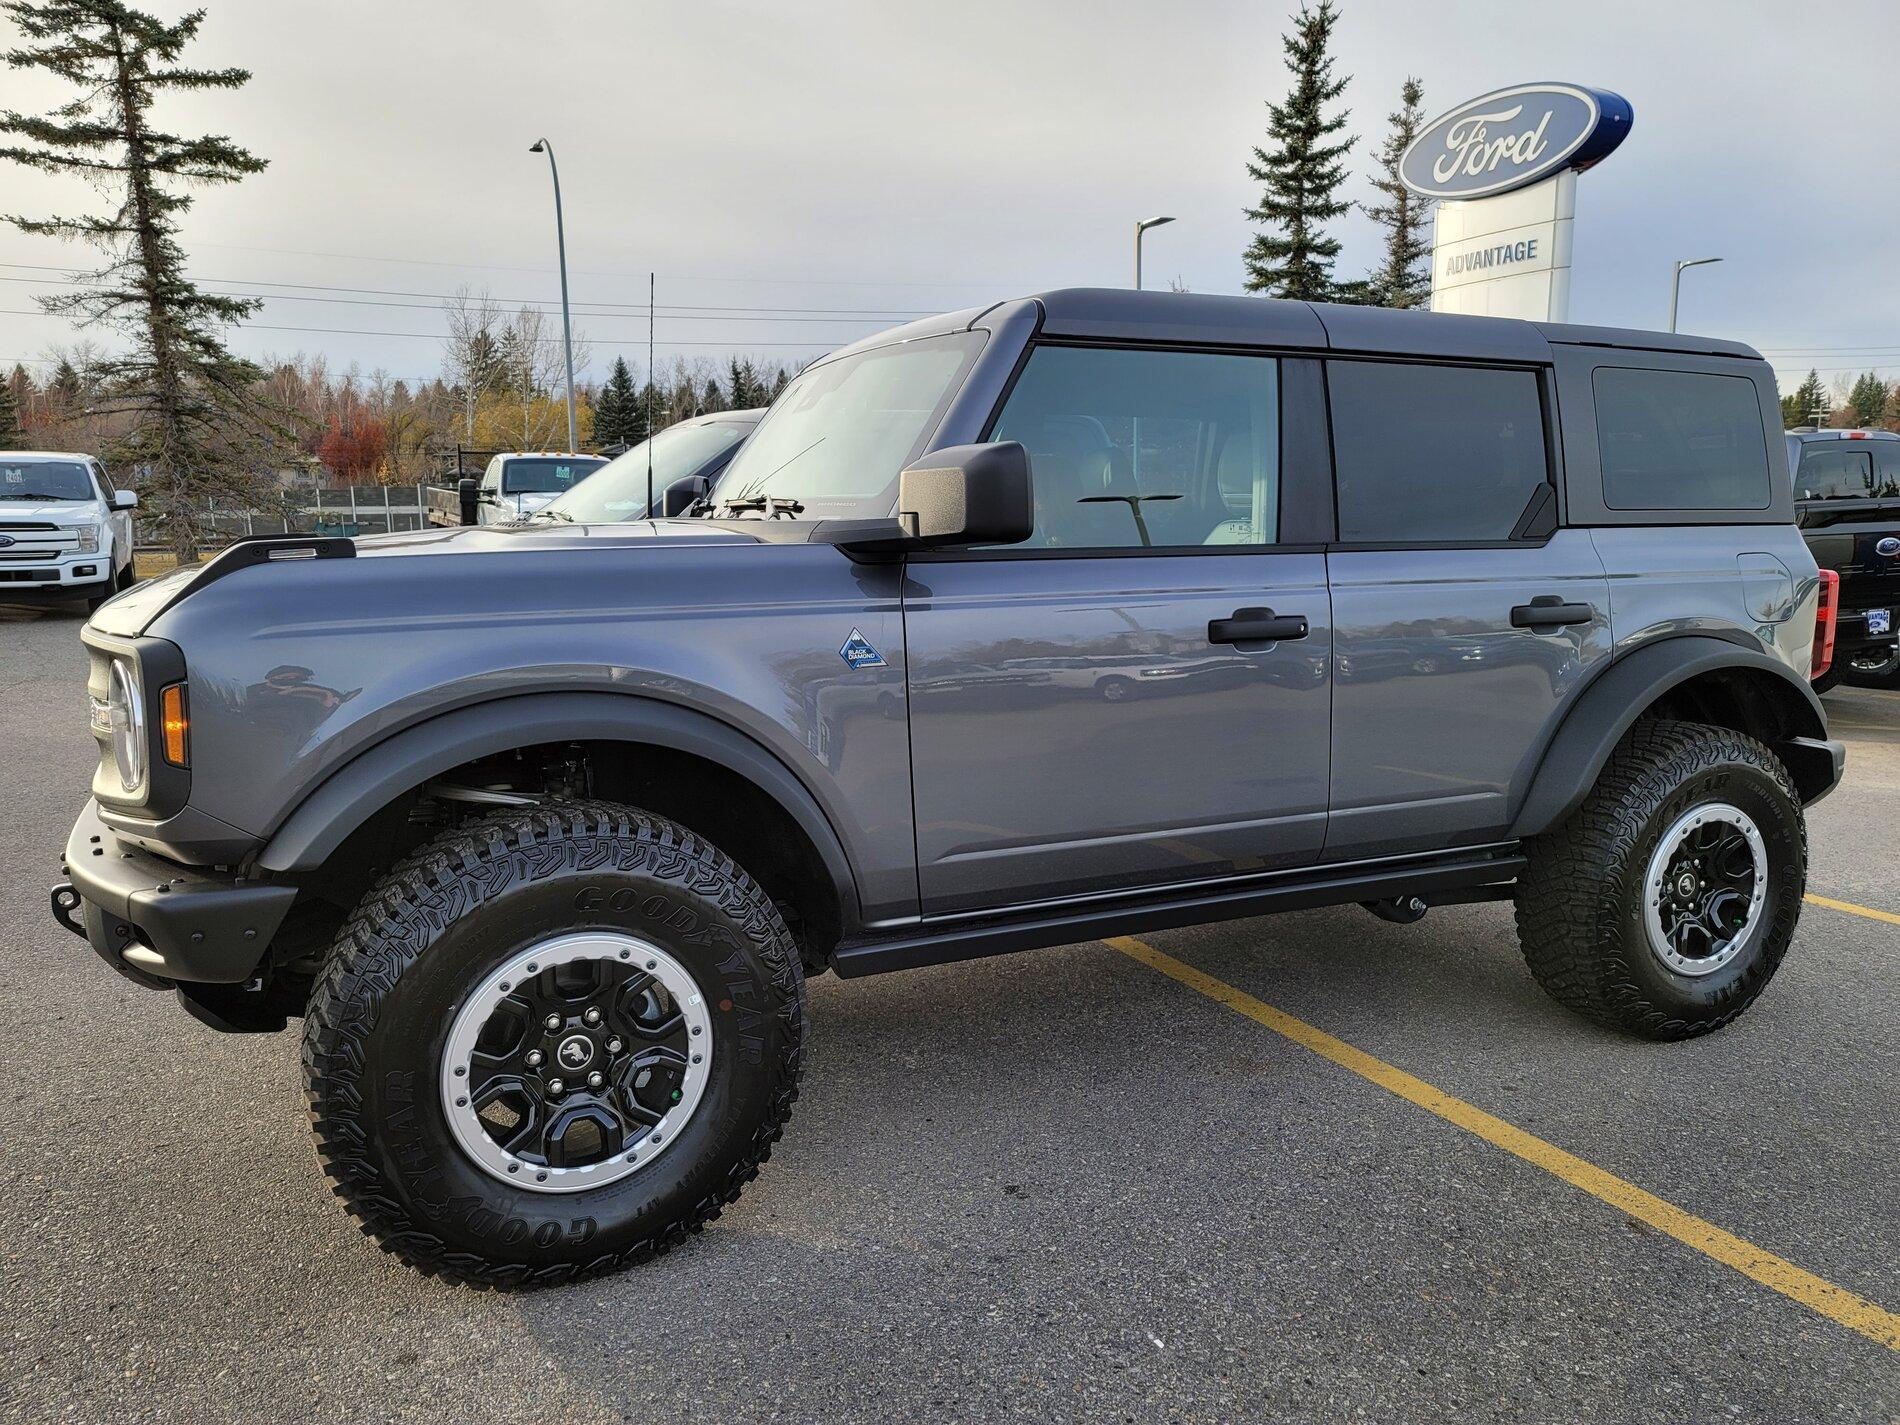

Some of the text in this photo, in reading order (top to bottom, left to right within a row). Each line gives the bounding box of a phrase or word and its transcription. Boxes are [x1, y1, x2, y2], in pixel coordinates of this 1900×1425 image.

[1433, 105, 1553, 183] Ford
[1446, 239, 1538, 275] ADVANTAGE
[848, 652, 875, 660] DIAMOND
